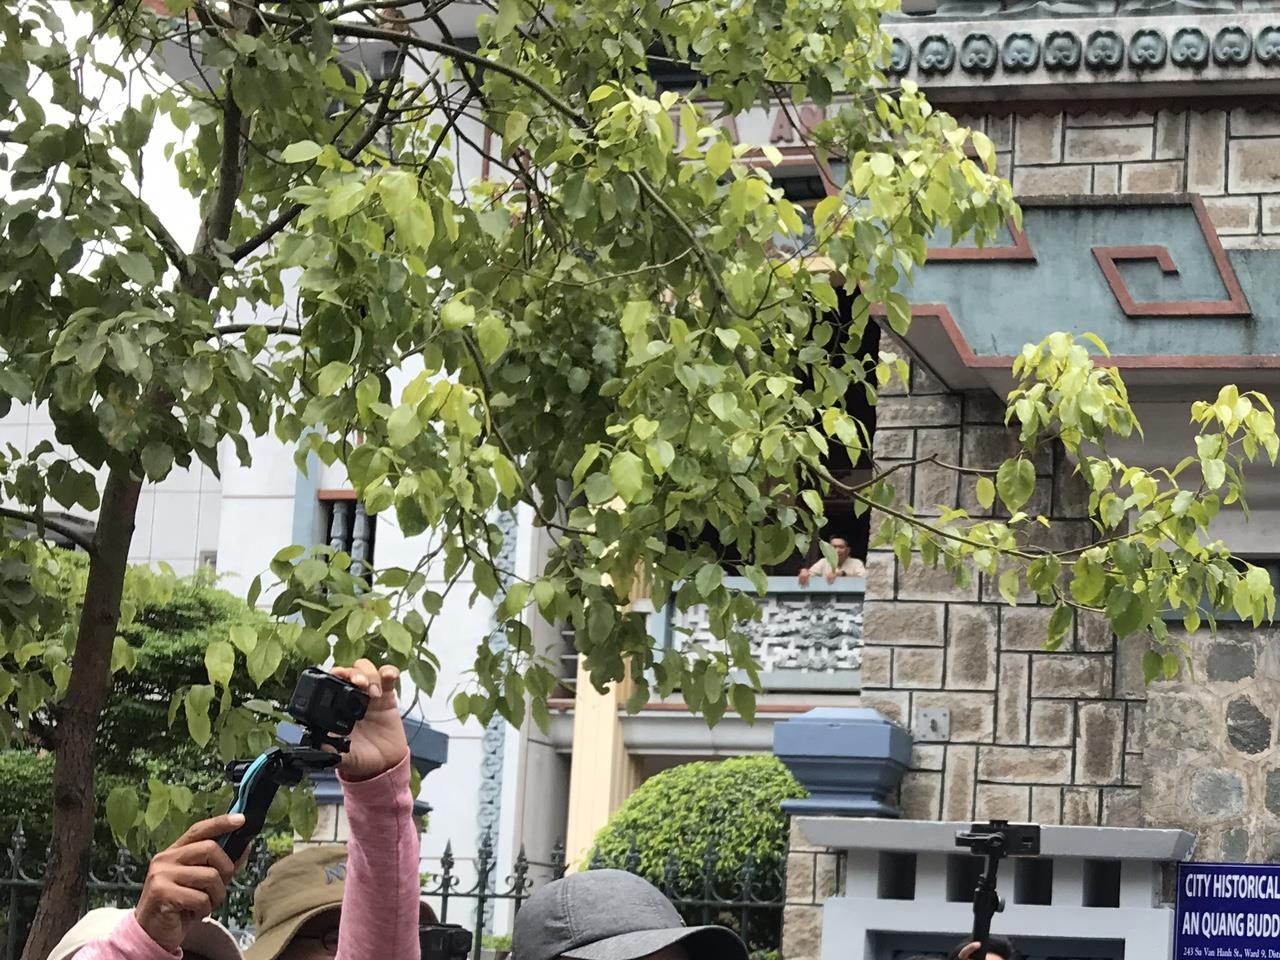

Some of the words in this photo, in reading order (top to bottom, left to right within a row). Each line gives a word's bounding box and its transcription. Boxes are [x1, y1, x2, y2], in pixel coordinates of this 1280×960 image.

[1185, 873, 1212, 898] CITY
[1213, 874, 1280, 900] HISTORICAL
[1182, 911, 1200, 936] AN
[1201, 912, 1245, 939] QUANG
[1183, 947, 1194, 956] 243
[1194, 947, 1202, 956] Su
[1203, 947, 1215, 957] Van
[1216, 947, 1232, 957] Hanh
[1244, 948, 1260, 958] Ward
